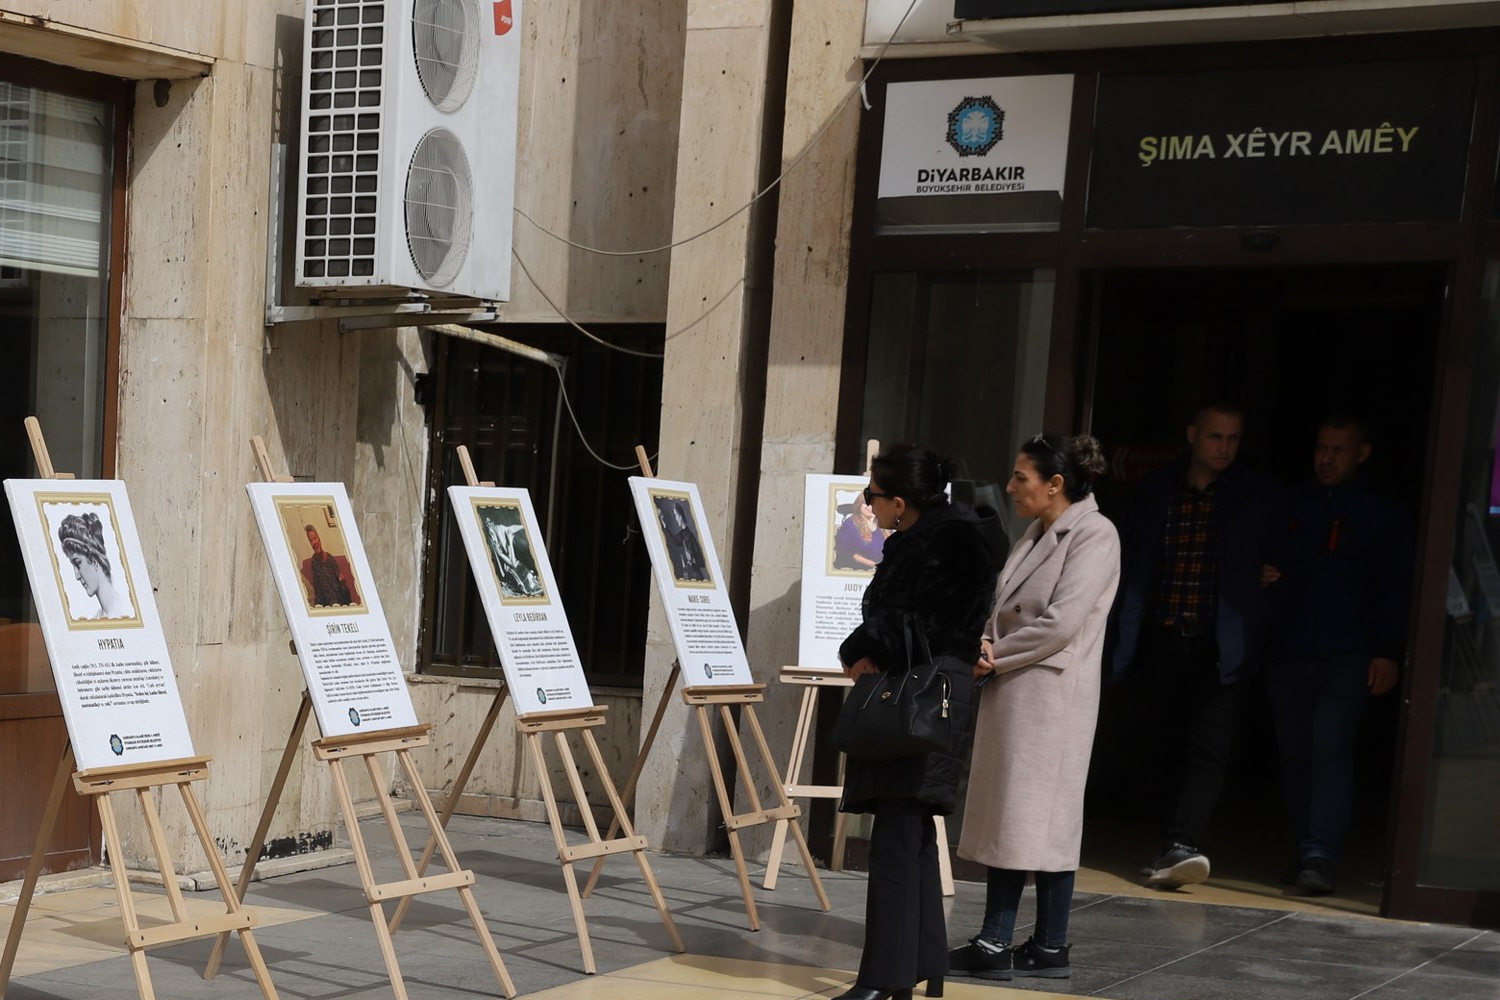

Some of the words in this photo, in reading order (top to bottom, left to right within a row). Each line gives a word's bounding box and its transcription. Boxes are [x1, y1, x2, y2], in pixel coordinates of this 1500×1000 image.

[1138, 135, 1216, 167] ŞIMA
[1223, 127, 1312, 158] XÊYR
[1319, 122, 1419, 155] AMÊY
[844, 583, 862, 592] JUDY
[97, 639, 125, 650] HYPATIA
